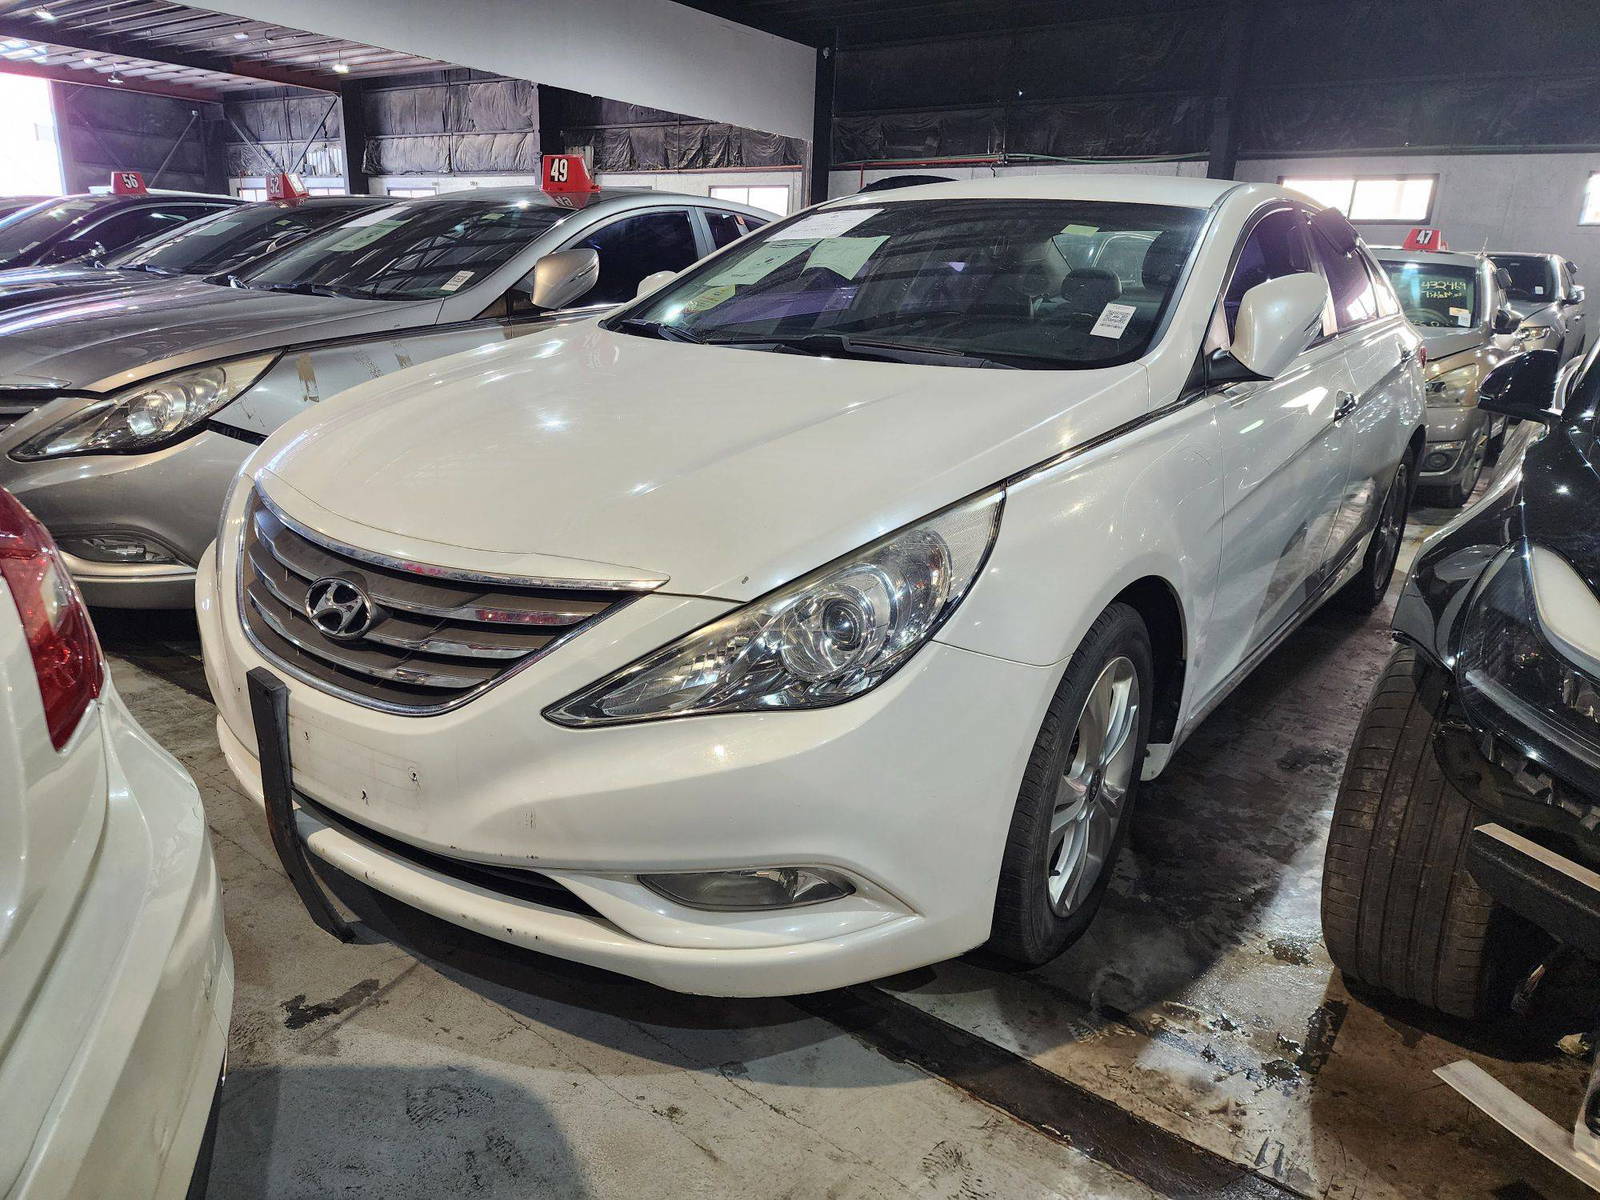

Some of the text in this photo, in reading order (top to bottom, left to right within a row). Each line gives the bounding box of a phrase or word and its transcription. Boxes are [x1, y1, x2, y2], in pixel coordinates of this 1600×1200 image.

[550, 158, 568, 182] 49
[121, 173, 139, 188] 56
[1416, 229, 1433, 245] 47
